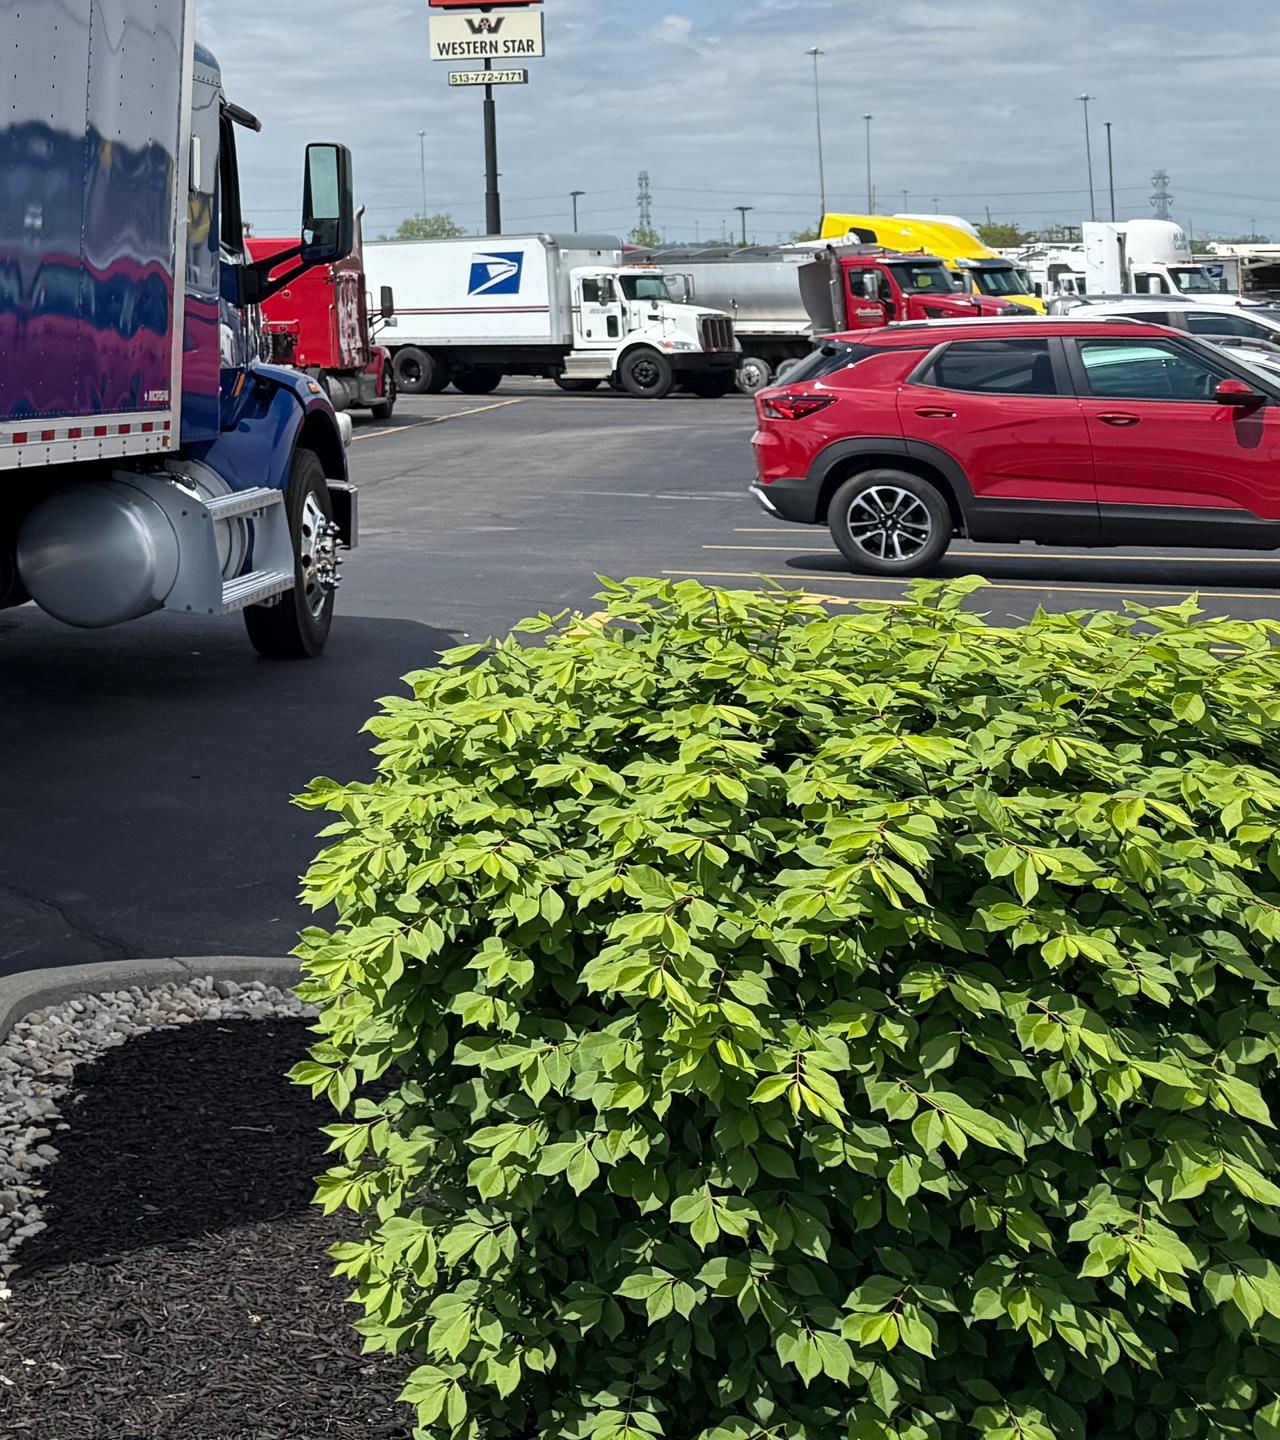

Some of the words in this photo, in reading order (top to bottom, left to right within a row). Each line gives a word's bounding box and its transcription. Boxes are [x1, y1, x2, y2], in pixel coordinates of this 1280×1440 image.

[437, 40, 498, 56] WESTERN
[503, 39, 535, 53] STAR
[451, 72, 522, 83] 513-772-7171
